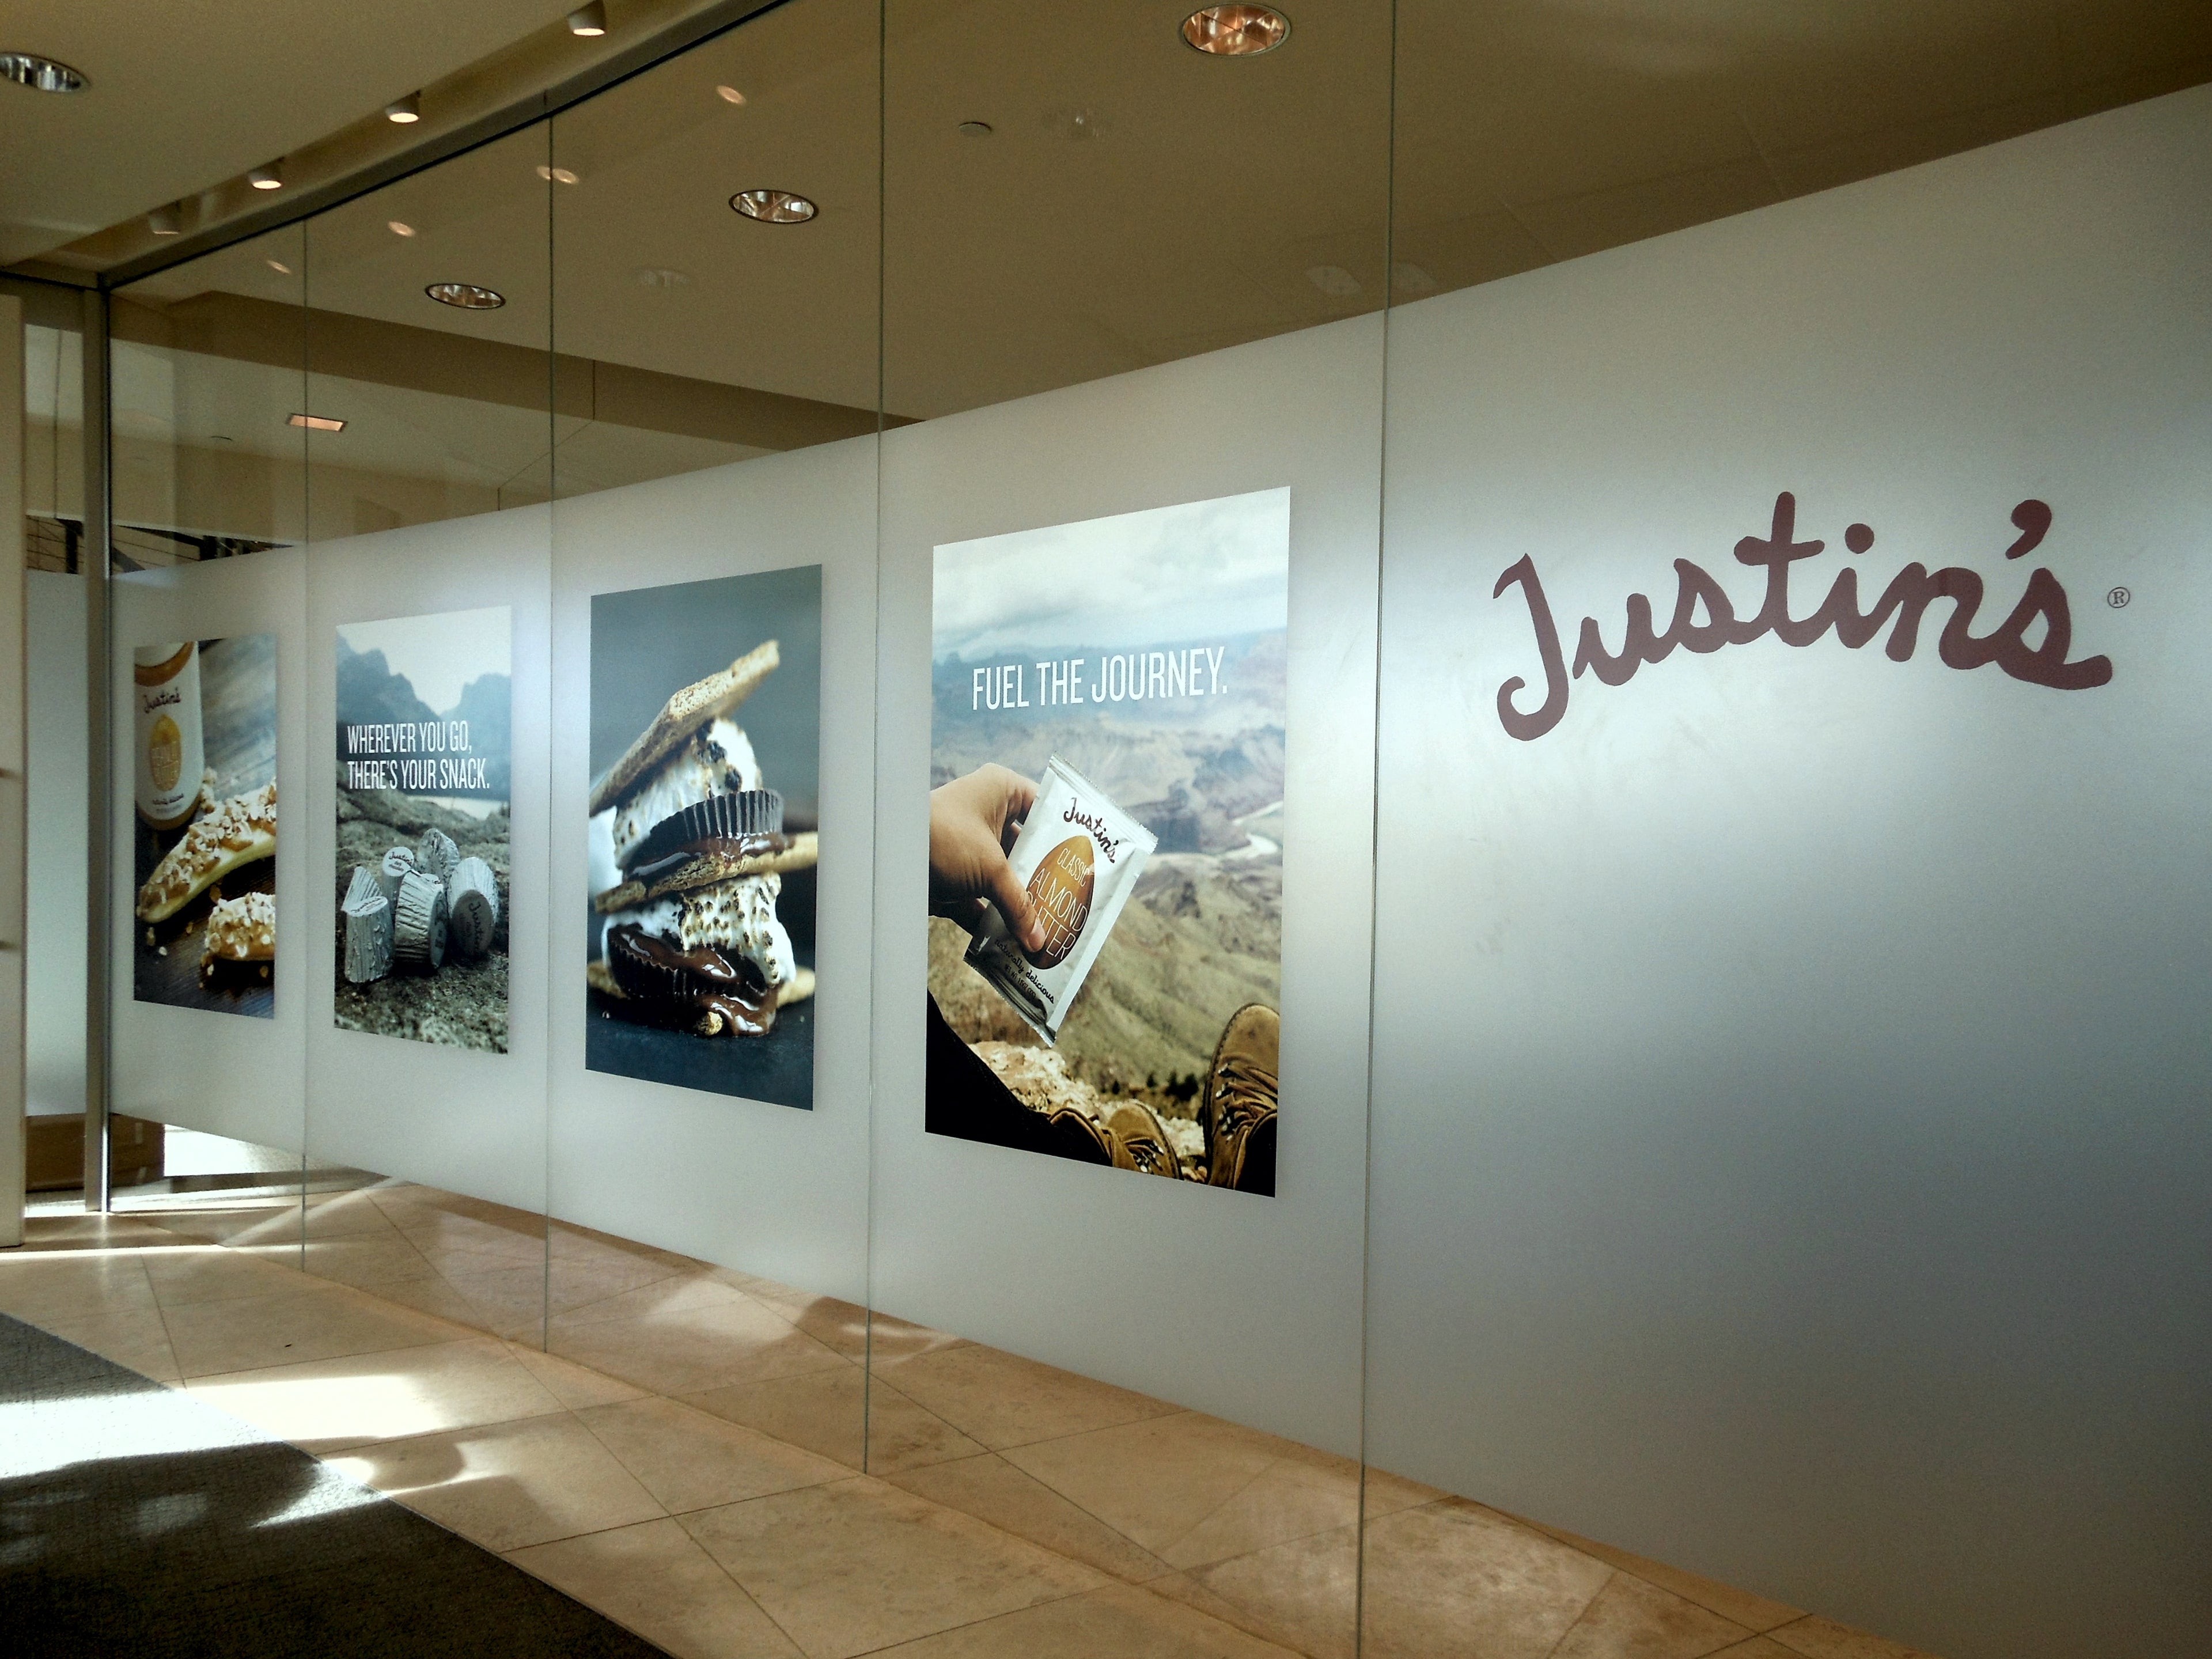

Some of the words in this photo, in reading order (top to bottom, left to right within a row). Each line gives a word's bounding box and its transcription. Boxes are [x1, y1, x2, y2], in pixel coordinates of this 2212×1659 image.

[1493, 491, 2112, 741] Justin's
[972, 665, 1029, 710] FUEL
[1036, 658, 1084, 706] THE
[1092, 646, 1228, 703] JOURNEY.
[347, 722, 416, 753] WHEREVER
[419, 721, 446, 752] YOU
[449, 720, 472, 754] GO,
[347, 759, 397, 790] THERE'S
[401, 759, 437, 790] YOUR
[440, 757, 490, 790] SNACK.
[1063, 797, 1119, 863] Justin's
[1056, 847, 1090, 887] CLASSIC
[1029, 868, 1088, 932] ALMOND
[1026, 969, 1055, 1005] delicious
